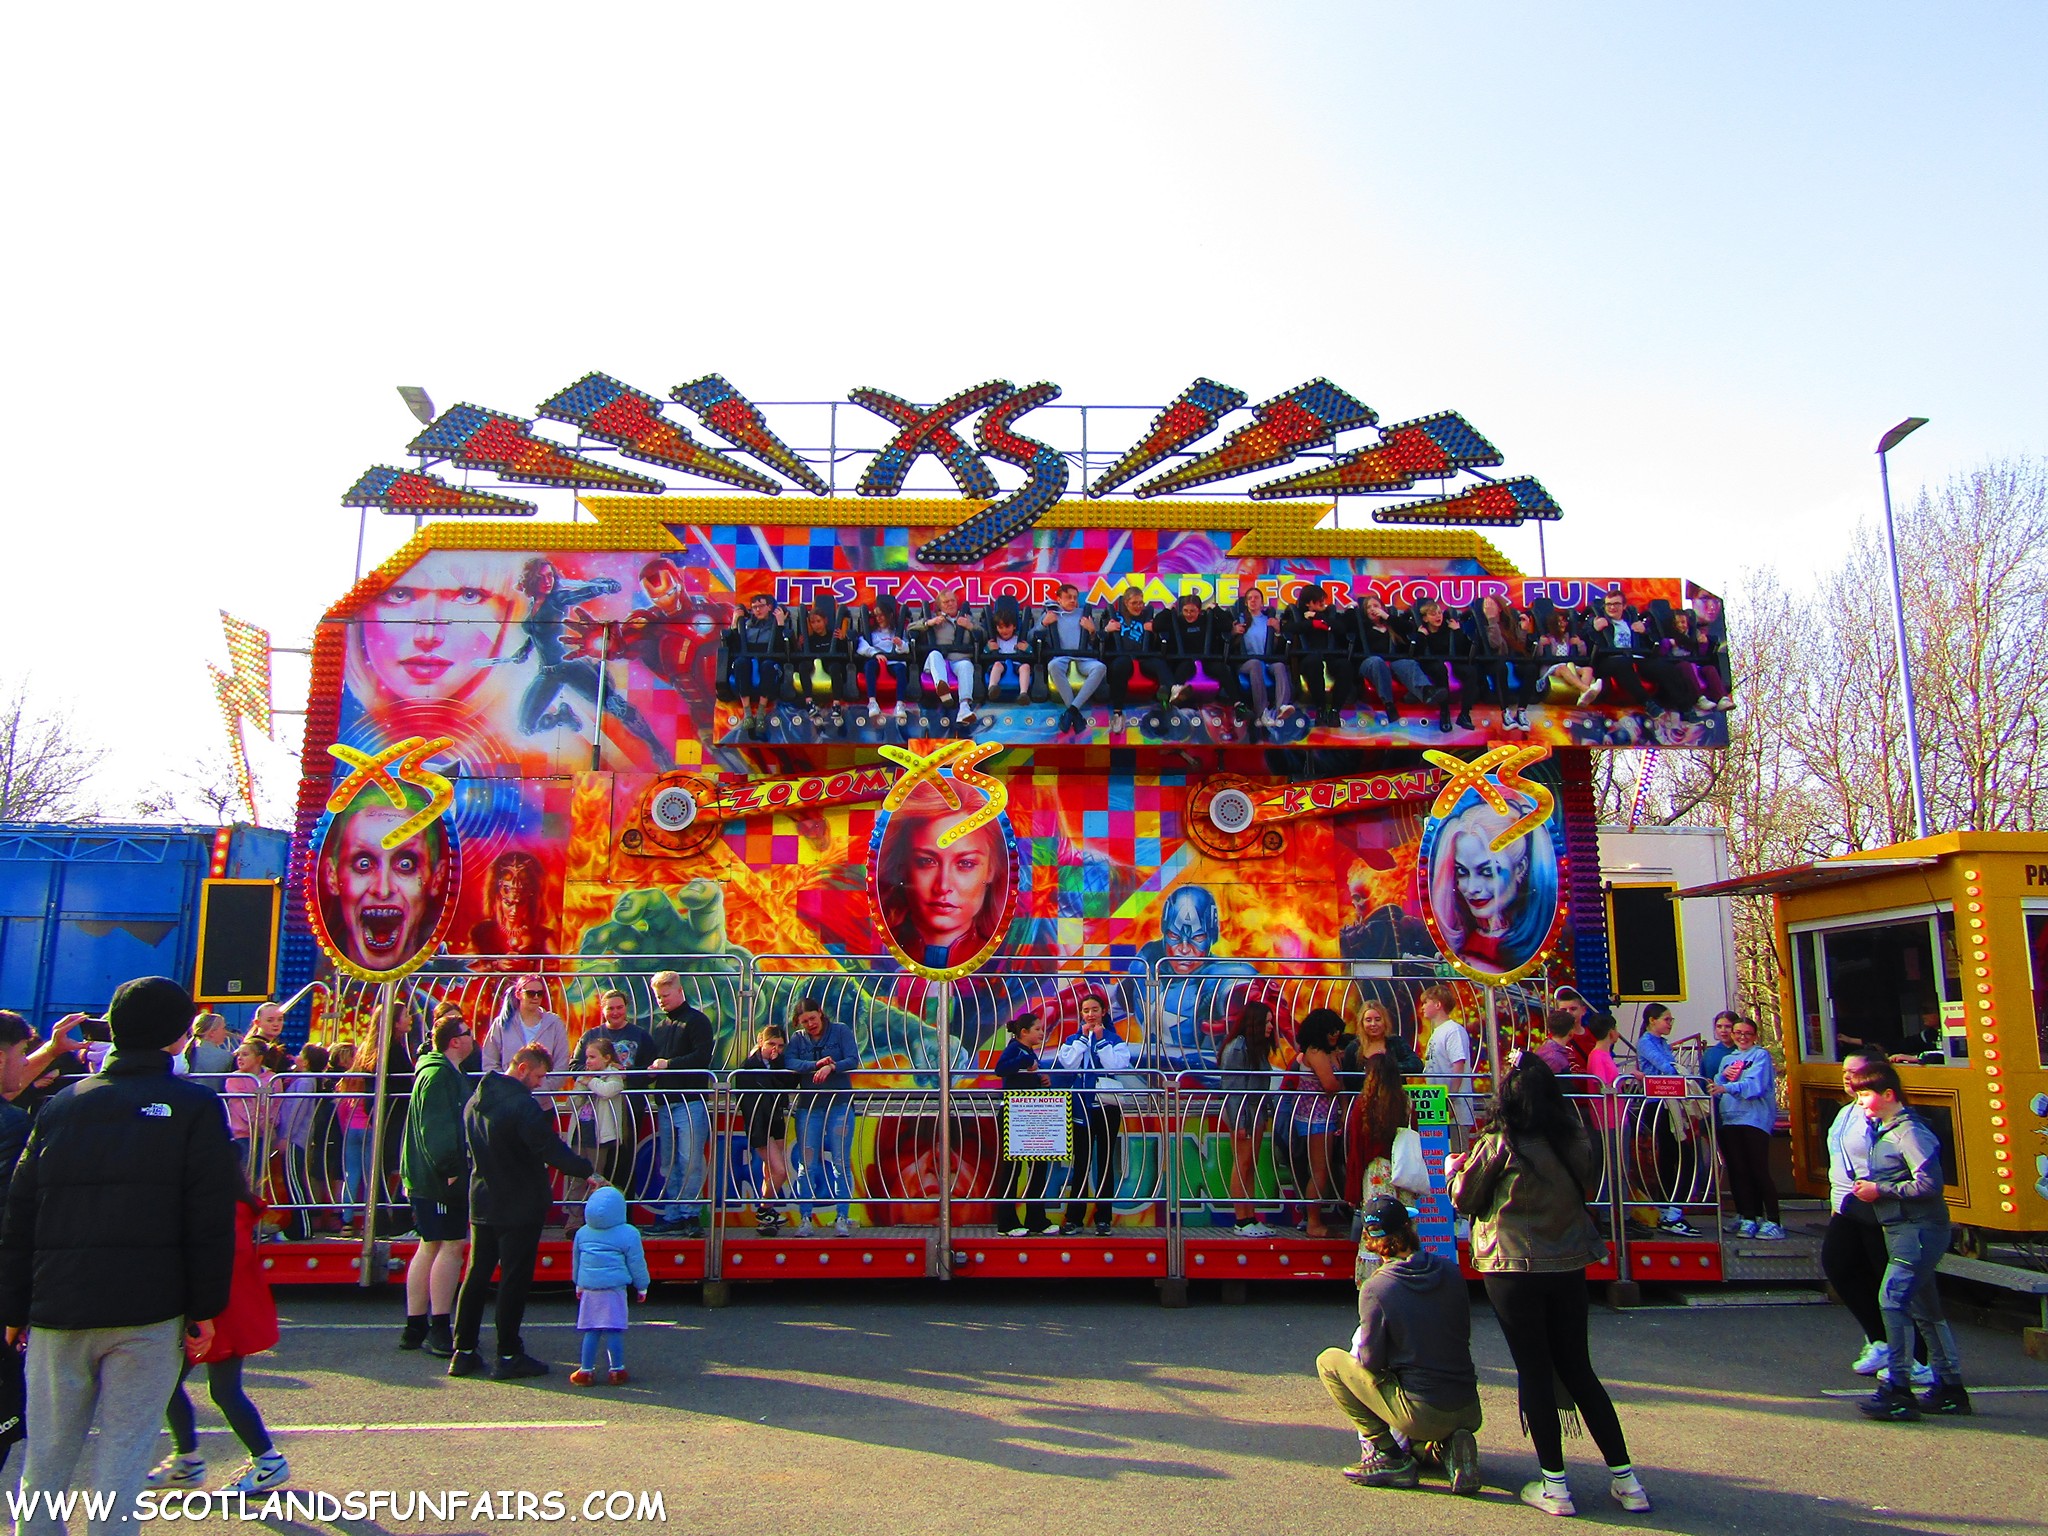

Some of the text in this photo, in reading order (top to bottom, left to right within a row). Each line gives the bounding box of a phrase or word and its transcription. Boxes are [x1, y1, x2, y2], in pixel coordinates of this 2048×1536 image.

[848, 377, 1062, 564] XS
[774, 576, 857, 605] IT'S
[865, 574, 1066, 606] TAYLOR
[1369, 580, 1512, 609] YOUR
[326, 736, 455, 850] XS
[878, 739, 1008, 849] XS
[1422, 745, 1554, 852] XS
[1407, 1090, 1440, 1099] KAY
